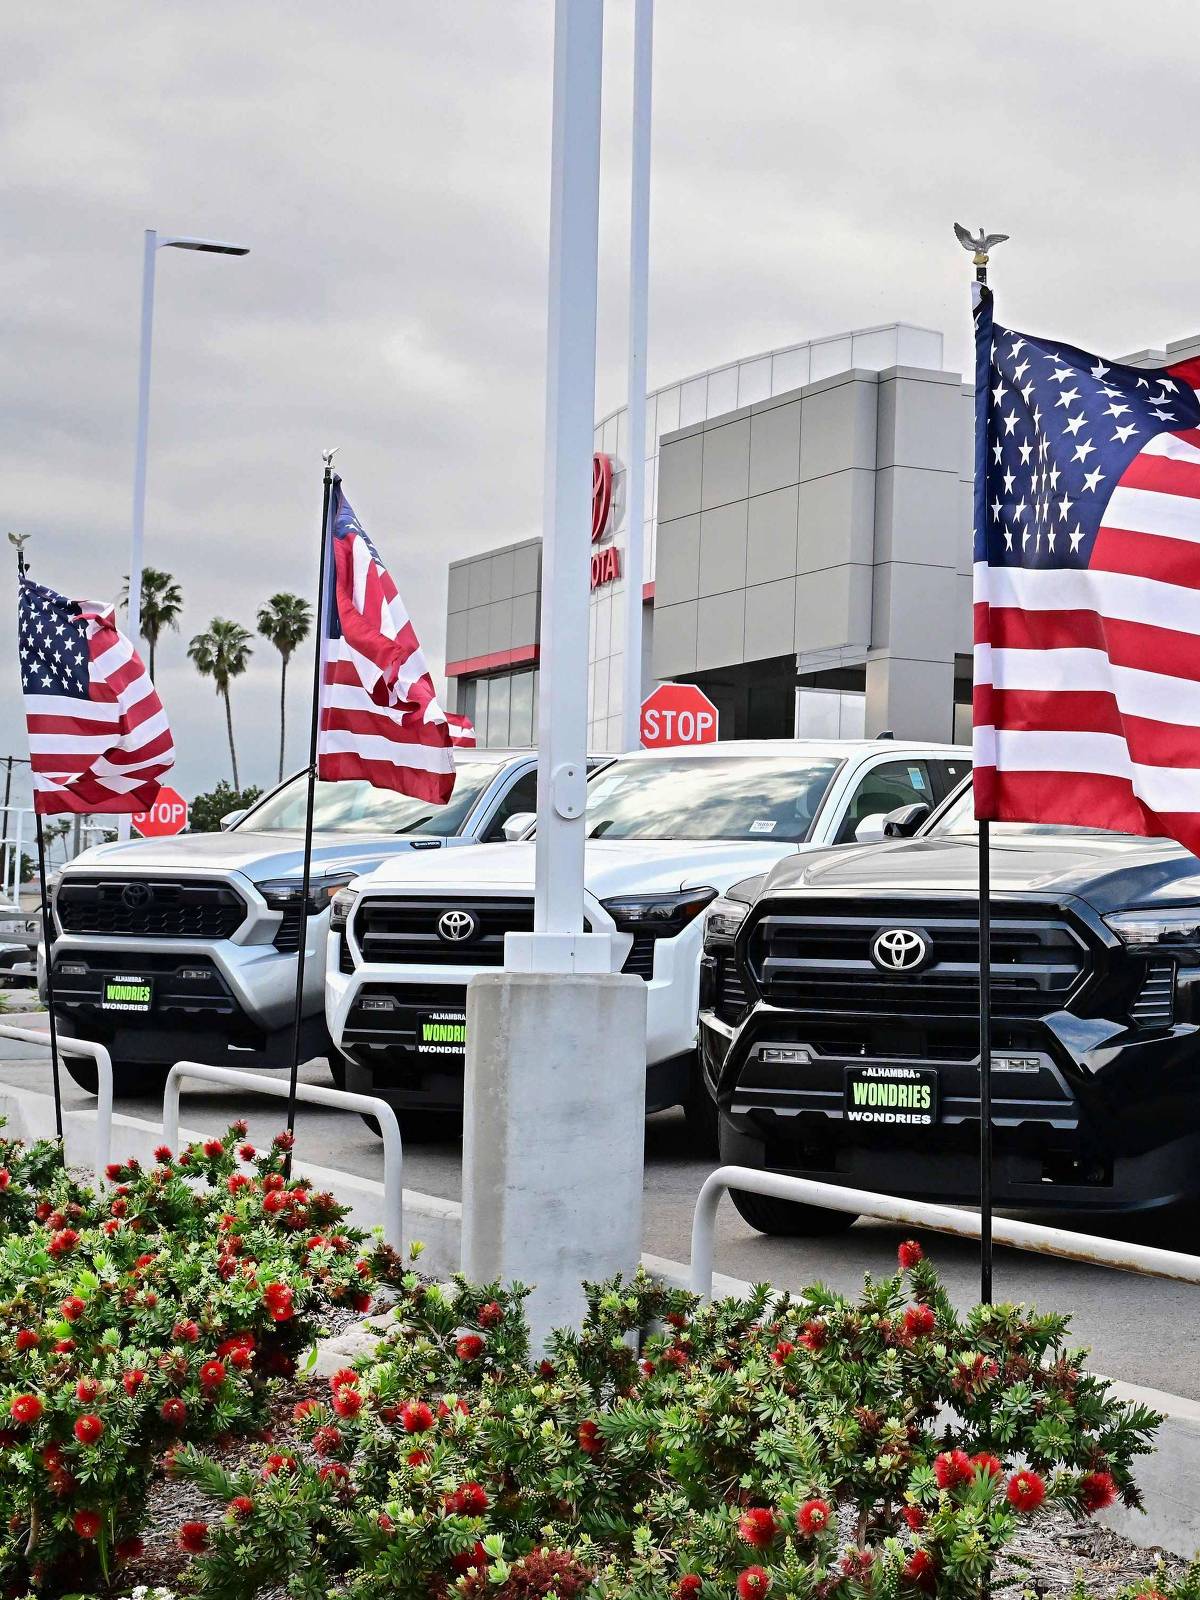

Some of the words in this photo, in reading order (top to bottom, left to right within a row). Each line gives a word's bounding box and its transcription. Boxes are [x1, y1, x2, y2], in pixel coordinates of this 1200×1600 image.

[591, 547, 620, 588] OTA
[643, 709, 713, 742] STOP
[107, 985, 150, 1001] WONDRIES
[102, 1002, 149, 1011] WONDRIES
[422, 1023, 467, 1042] WONDRI
[418, 1045, 466, 1054] WONDRI
[866, 1067, 916, 1079] ALHAMBRA
[852, 1082, 931, 1109] WONDRIES
[847, 1111, 932, 1125] WONDRIES
